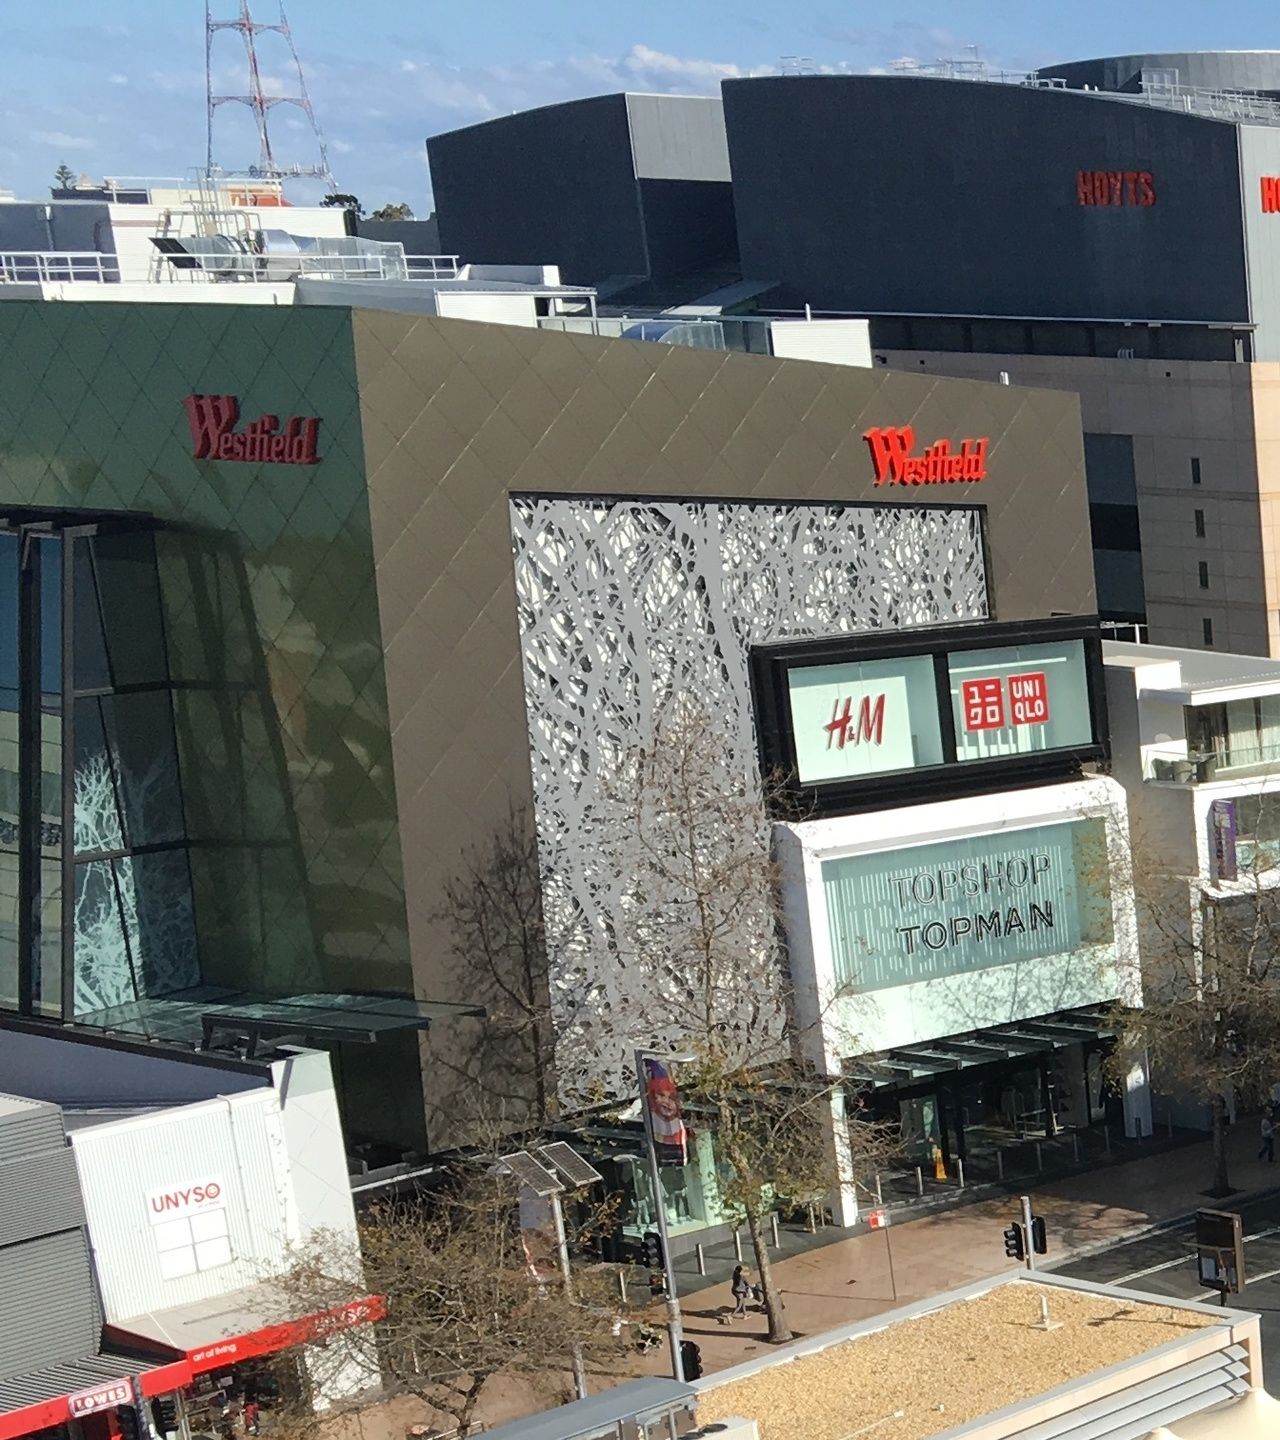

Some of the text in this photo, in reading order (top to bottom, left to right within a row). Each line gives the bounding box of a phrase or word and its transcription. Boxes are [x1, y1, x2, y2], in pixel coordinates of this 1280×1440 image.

[1076, 170, 1156, 207] HOYTS
[182, 393, 324, 465] Westfield
[862, 425, 990, 487] Westfield
[1012, 679, 1040, 699] UNI
[822, 693, 886, 751] H&M
[1014, 699, 1045, 722] QLO
[889, 853, 1051, 908] TOPSHOP
[897, 901, 1054, 954] TOPMAN
[151, 1182, 221, 1213] UNYSO
[214, 1343, 237, 1356] living
[75, 1386, 125, 1410] LOWES
